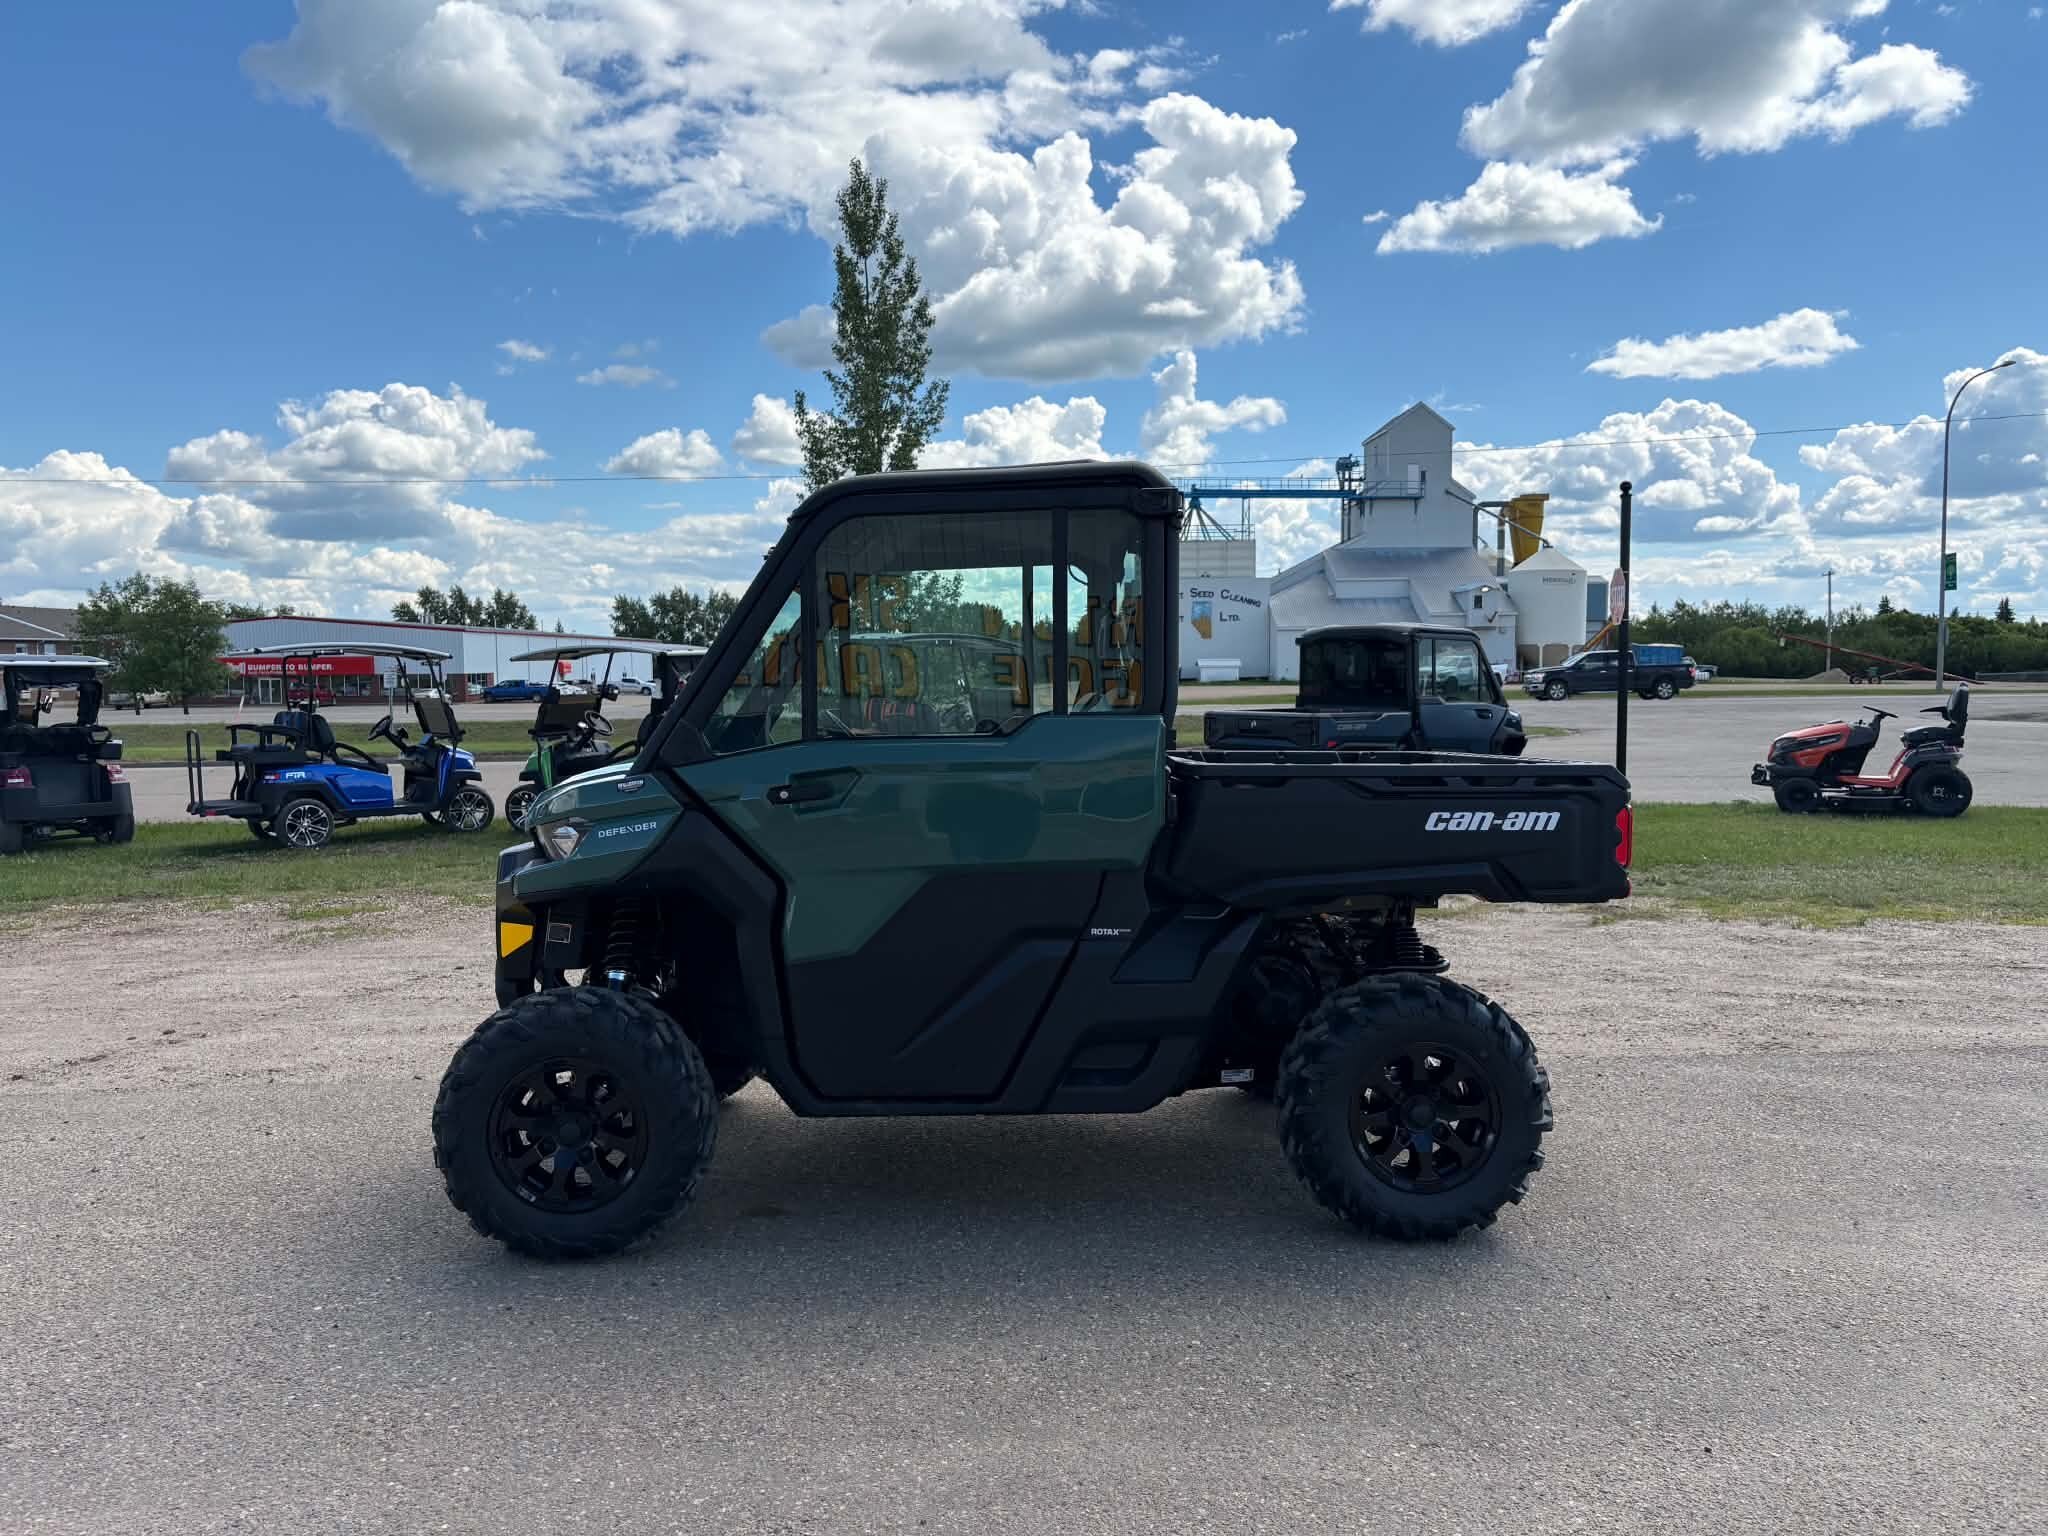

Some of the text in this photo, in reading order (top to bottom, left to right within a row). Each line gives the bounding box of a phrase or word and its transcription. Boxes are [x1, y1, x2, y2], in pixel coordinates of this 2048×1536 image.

[247, 663, 282, 671] BUMPER
[1424, 811, 1561, 831] can-am
[598, 821, 657, 838] DEFENDER
[1090, 928, 1120, 936] ROTAX
